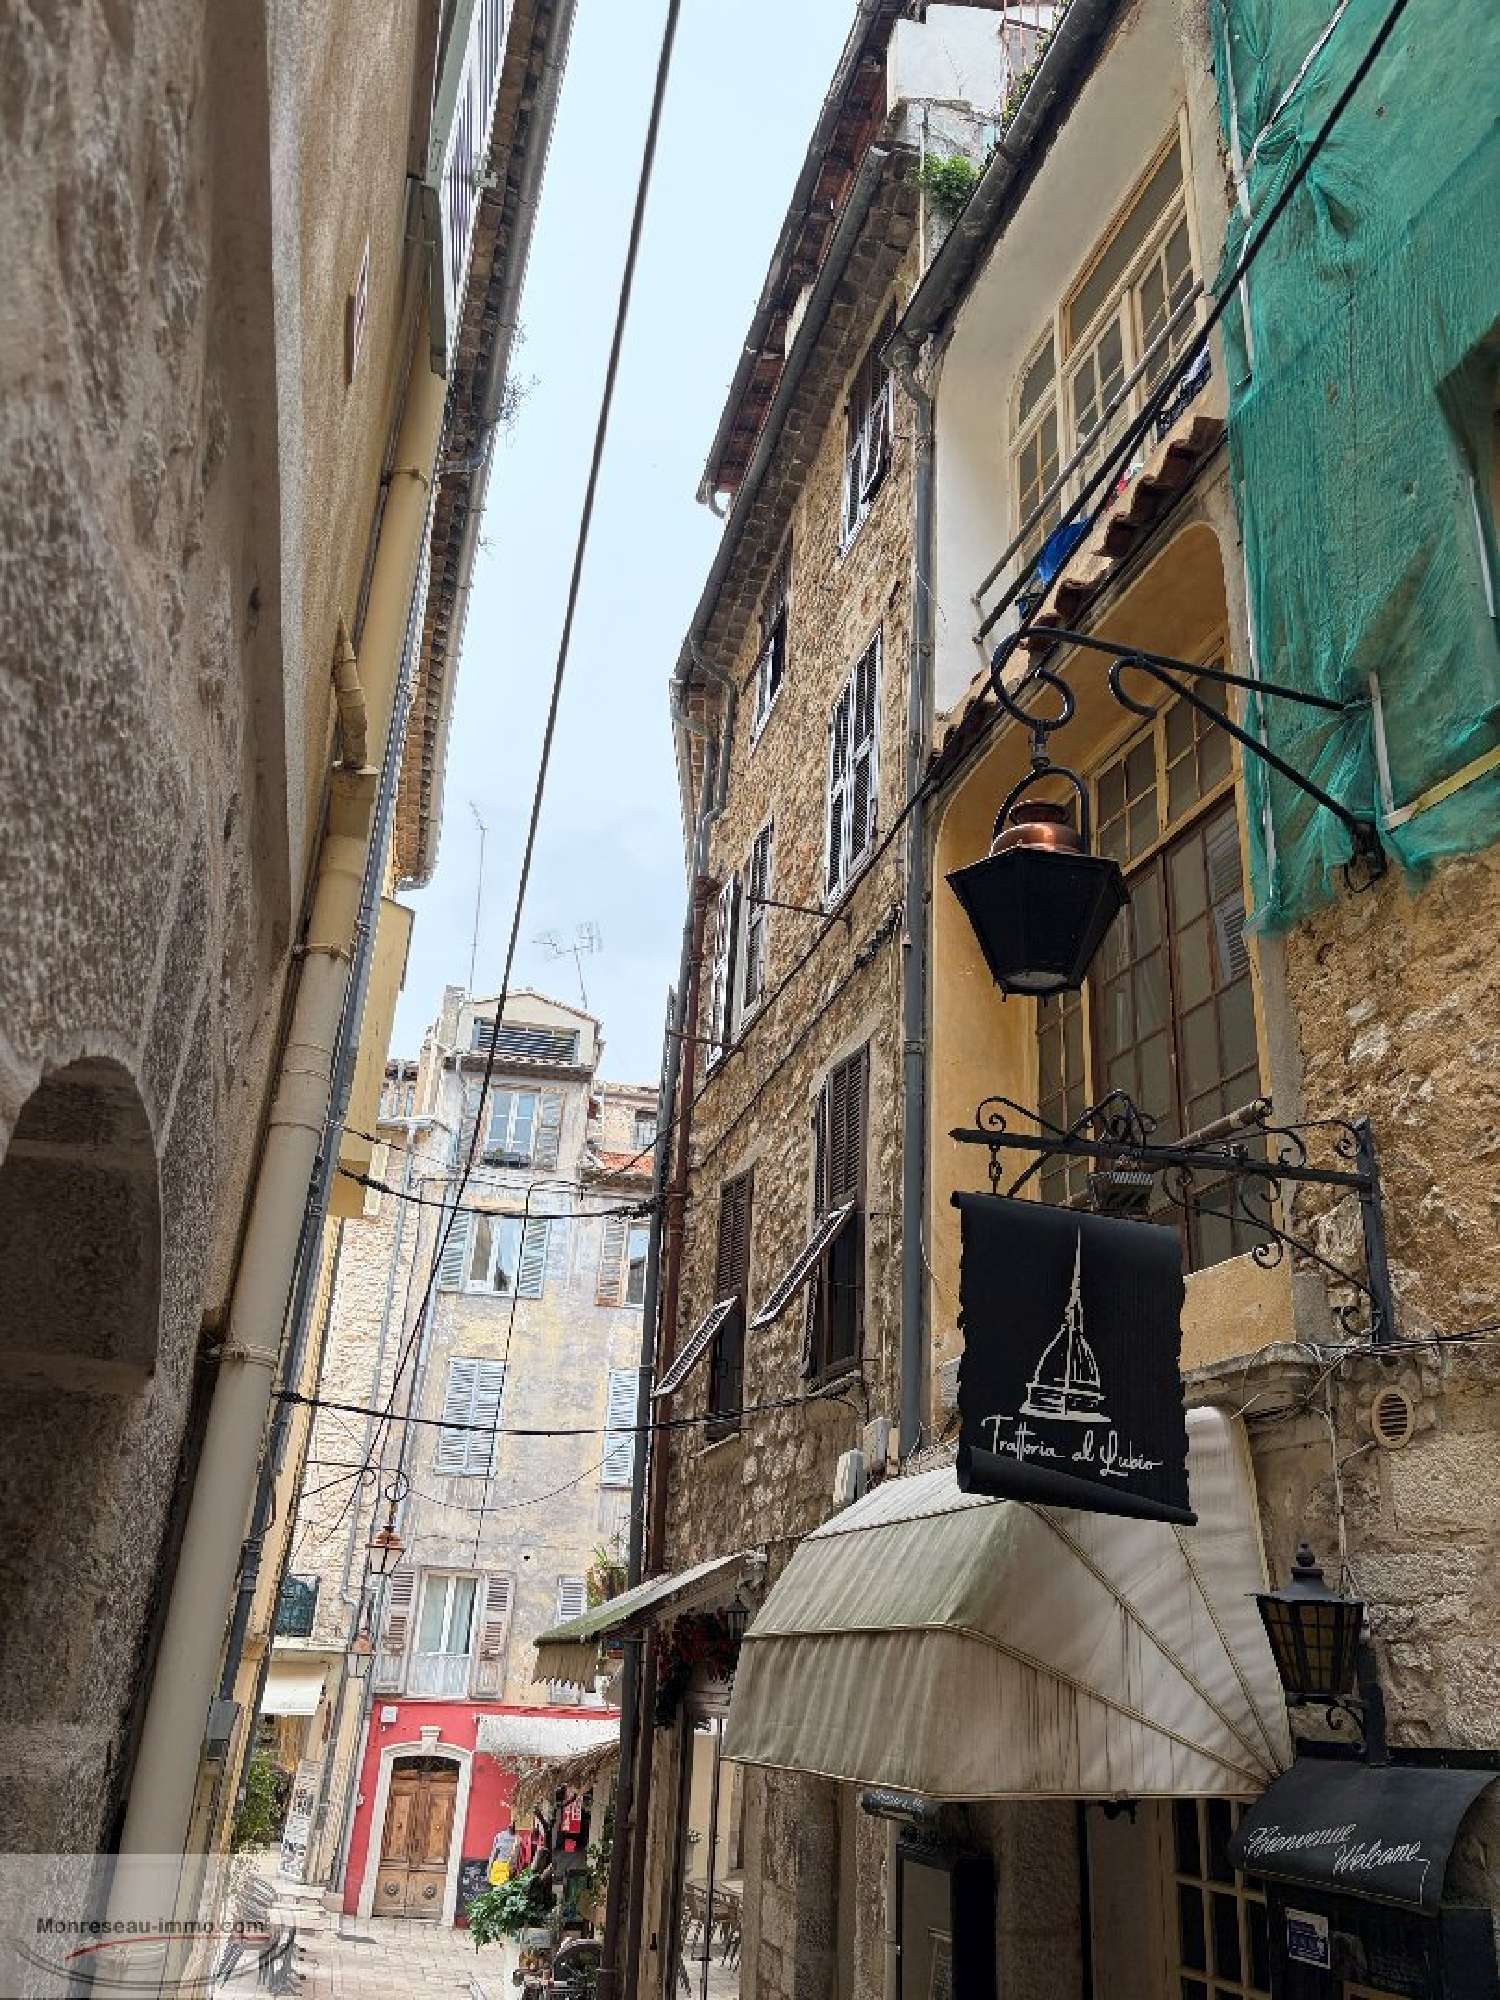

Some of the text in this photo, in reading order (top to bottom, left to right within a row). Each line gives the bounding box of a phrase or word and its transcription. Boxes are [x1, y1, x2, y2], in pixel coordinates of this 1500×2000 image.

[980, 1414, 1066, 1462] Trattoria
[1247, 1823, 1357, 1858] Bienvenue
[1332, 1838, 1422, 1876] Welcome
